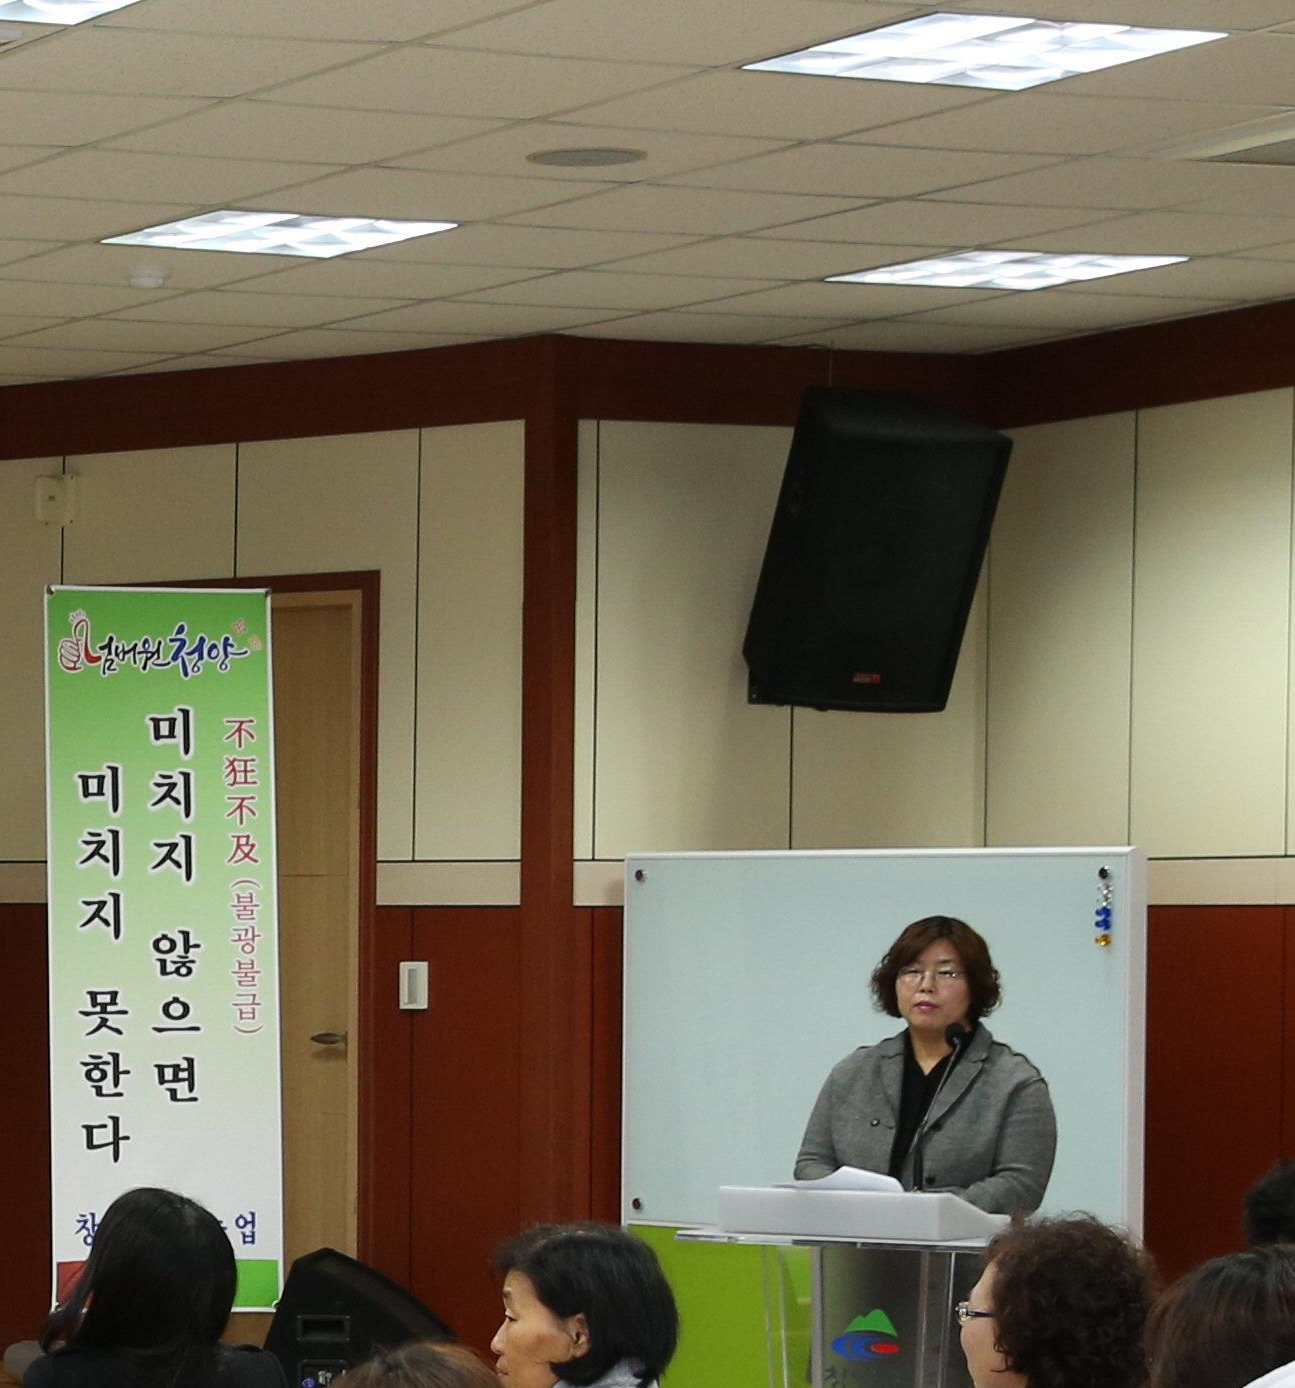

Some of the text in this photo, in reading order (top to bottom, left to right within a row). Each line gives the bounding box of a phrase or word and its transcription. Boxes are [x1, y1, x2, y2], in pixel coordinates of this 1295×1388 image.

[167, 622, 250, 679] 청양
[77, 764, 131, 1164] 미치지 못한다
[148, 705, 201, 1103] 미치지 않으면
